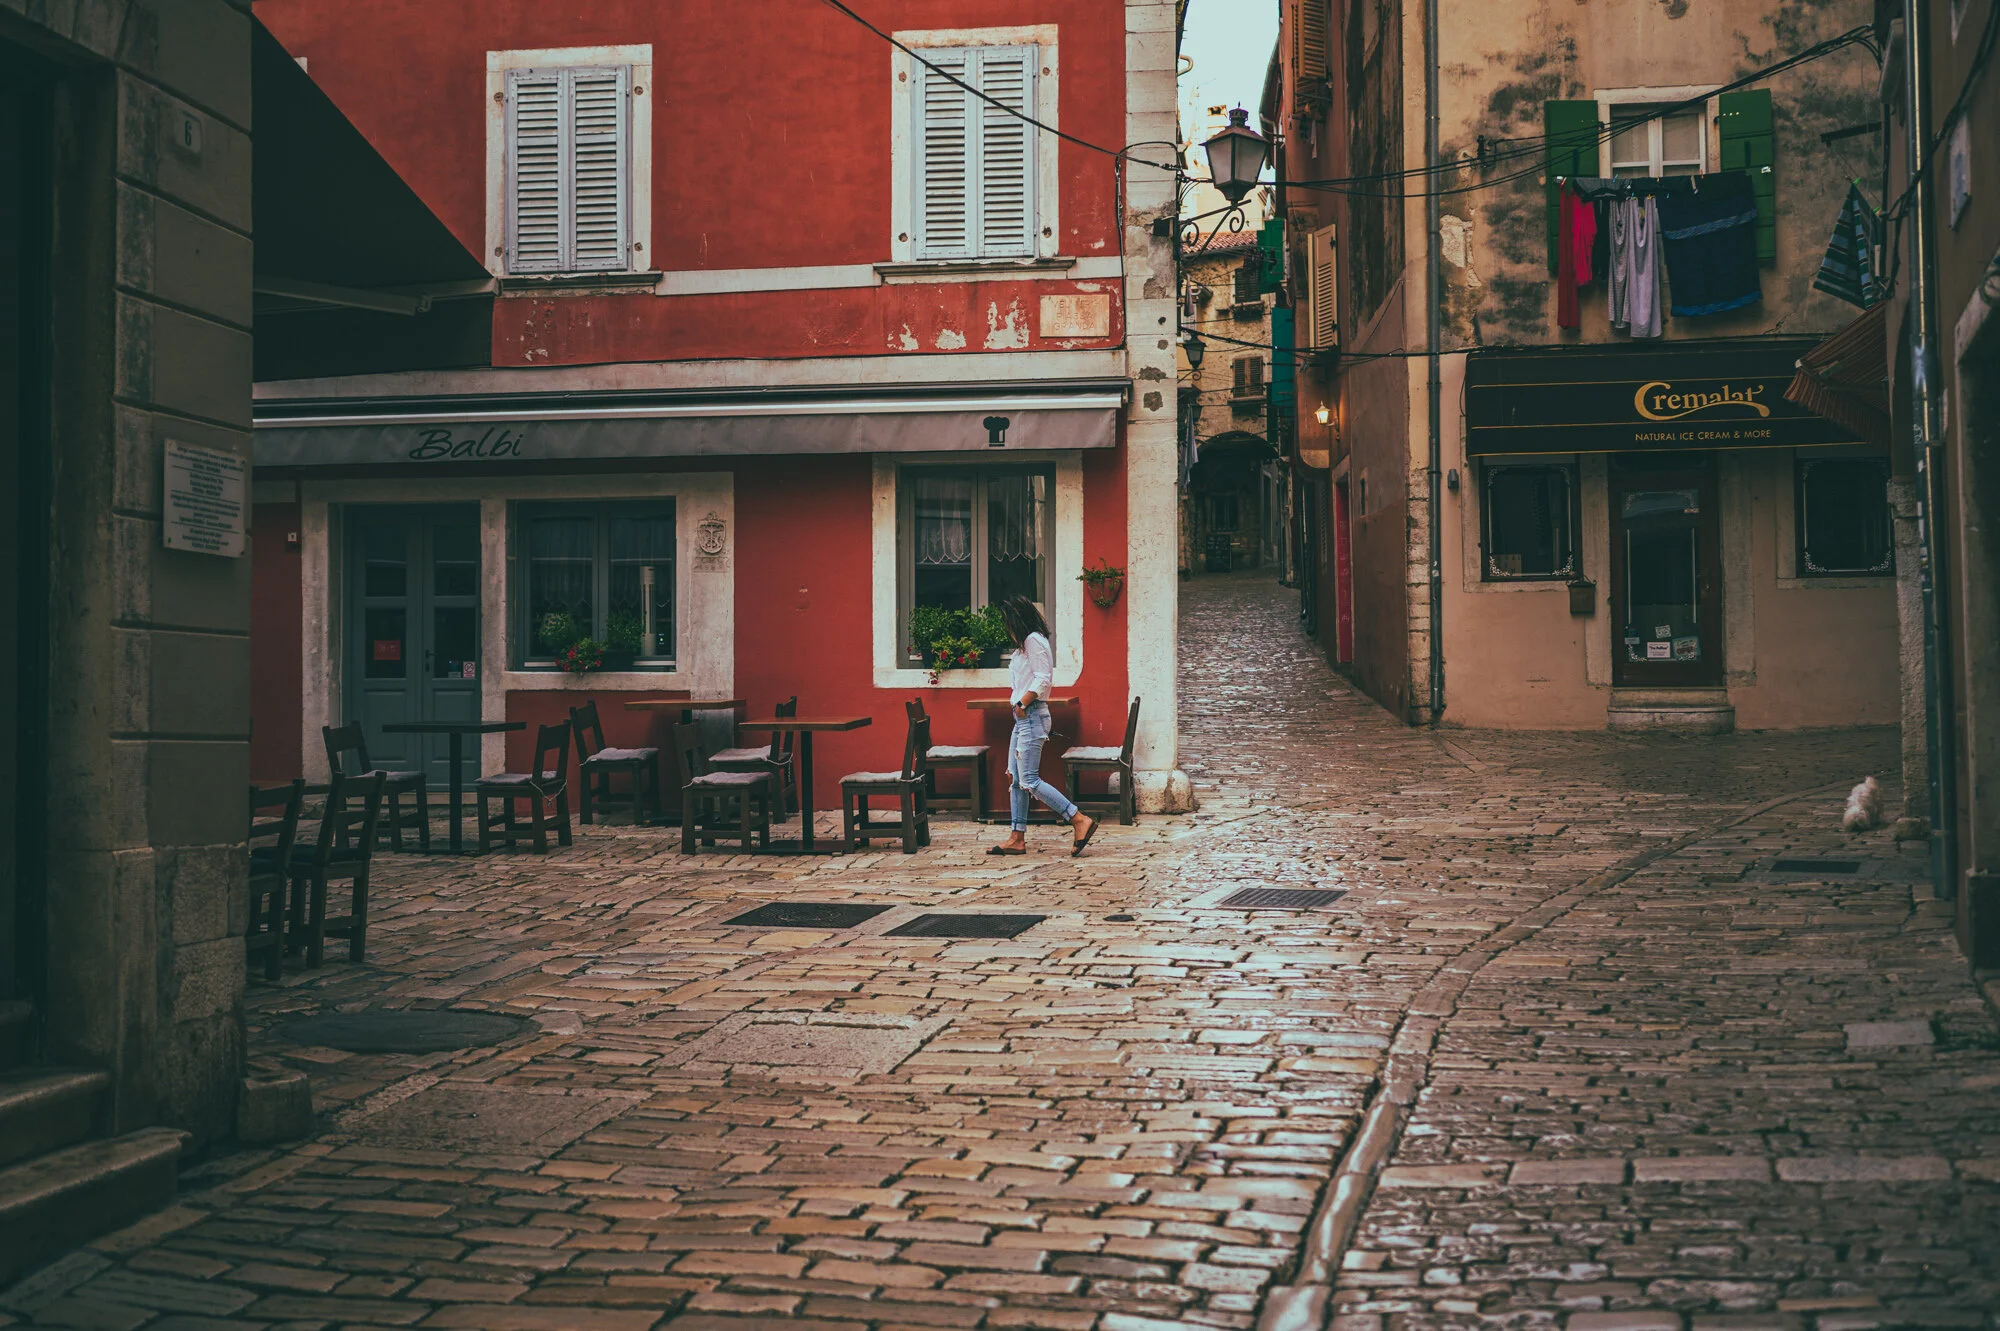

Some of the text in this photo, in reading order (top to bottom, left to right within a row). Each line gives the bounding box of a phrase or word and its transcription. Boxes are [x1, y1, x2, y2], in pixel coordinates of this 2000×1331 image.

[408, 427, 523, 460] Balbi
[1635, 429, 1772, 441] NATURAL ICE CREAM & MORE
